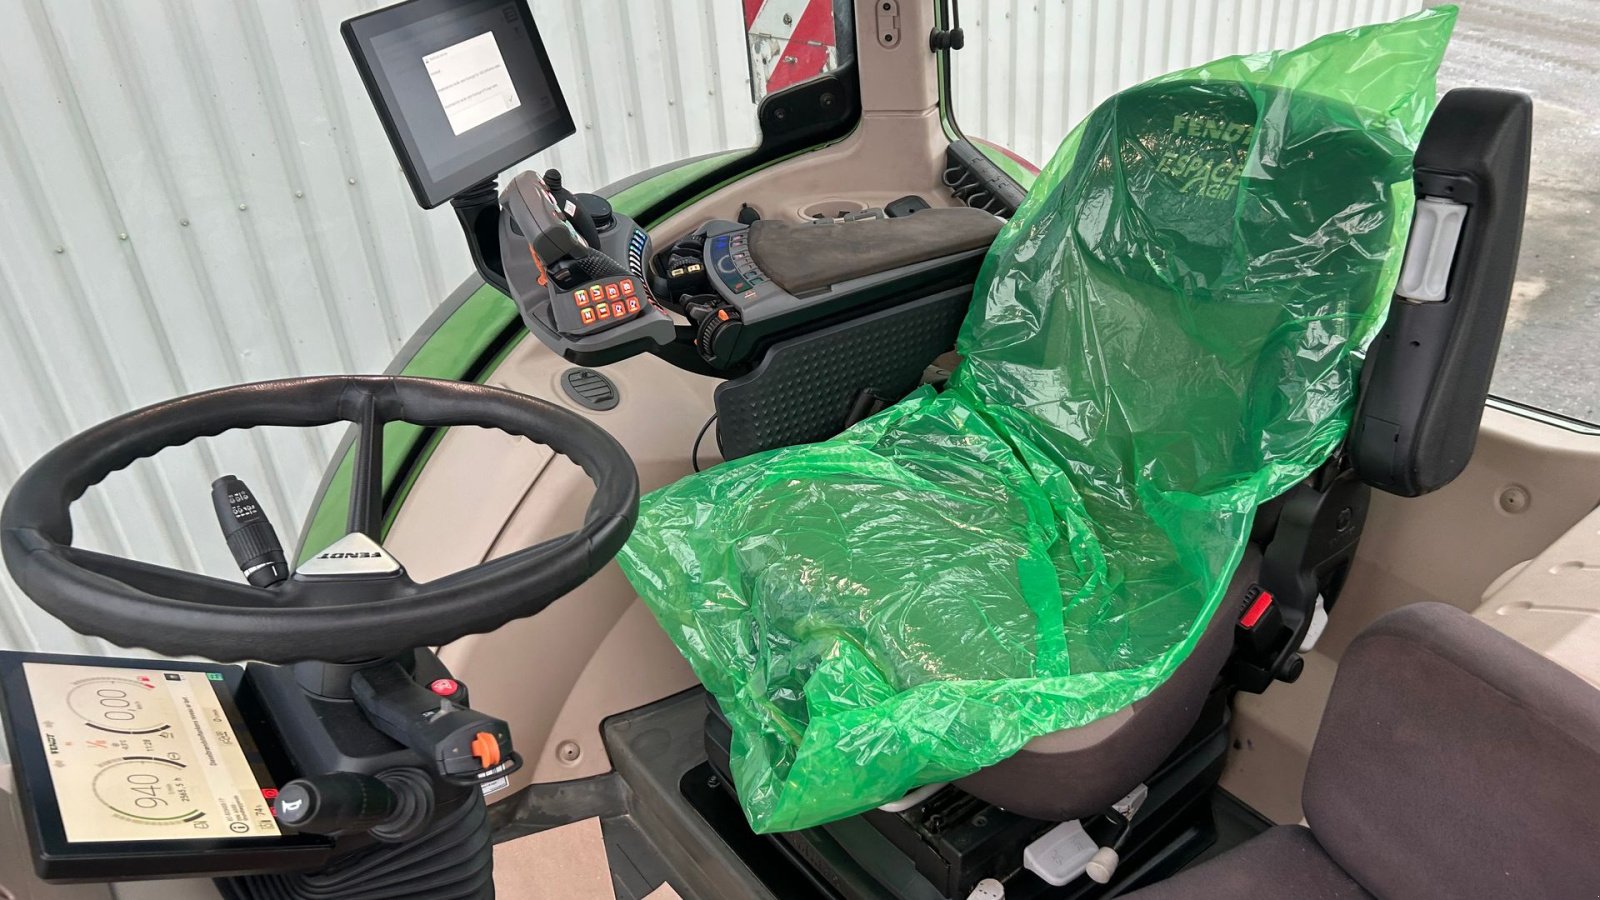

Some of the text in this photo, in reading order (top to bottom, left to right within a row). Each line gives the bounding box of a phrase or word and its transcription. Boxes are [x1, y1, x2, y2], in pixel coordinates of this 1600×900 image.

[1173, 115, 1255, 145] FENDT
[96, 689, 135, 720] 0,00
[127, 774, 168, 808] 940
